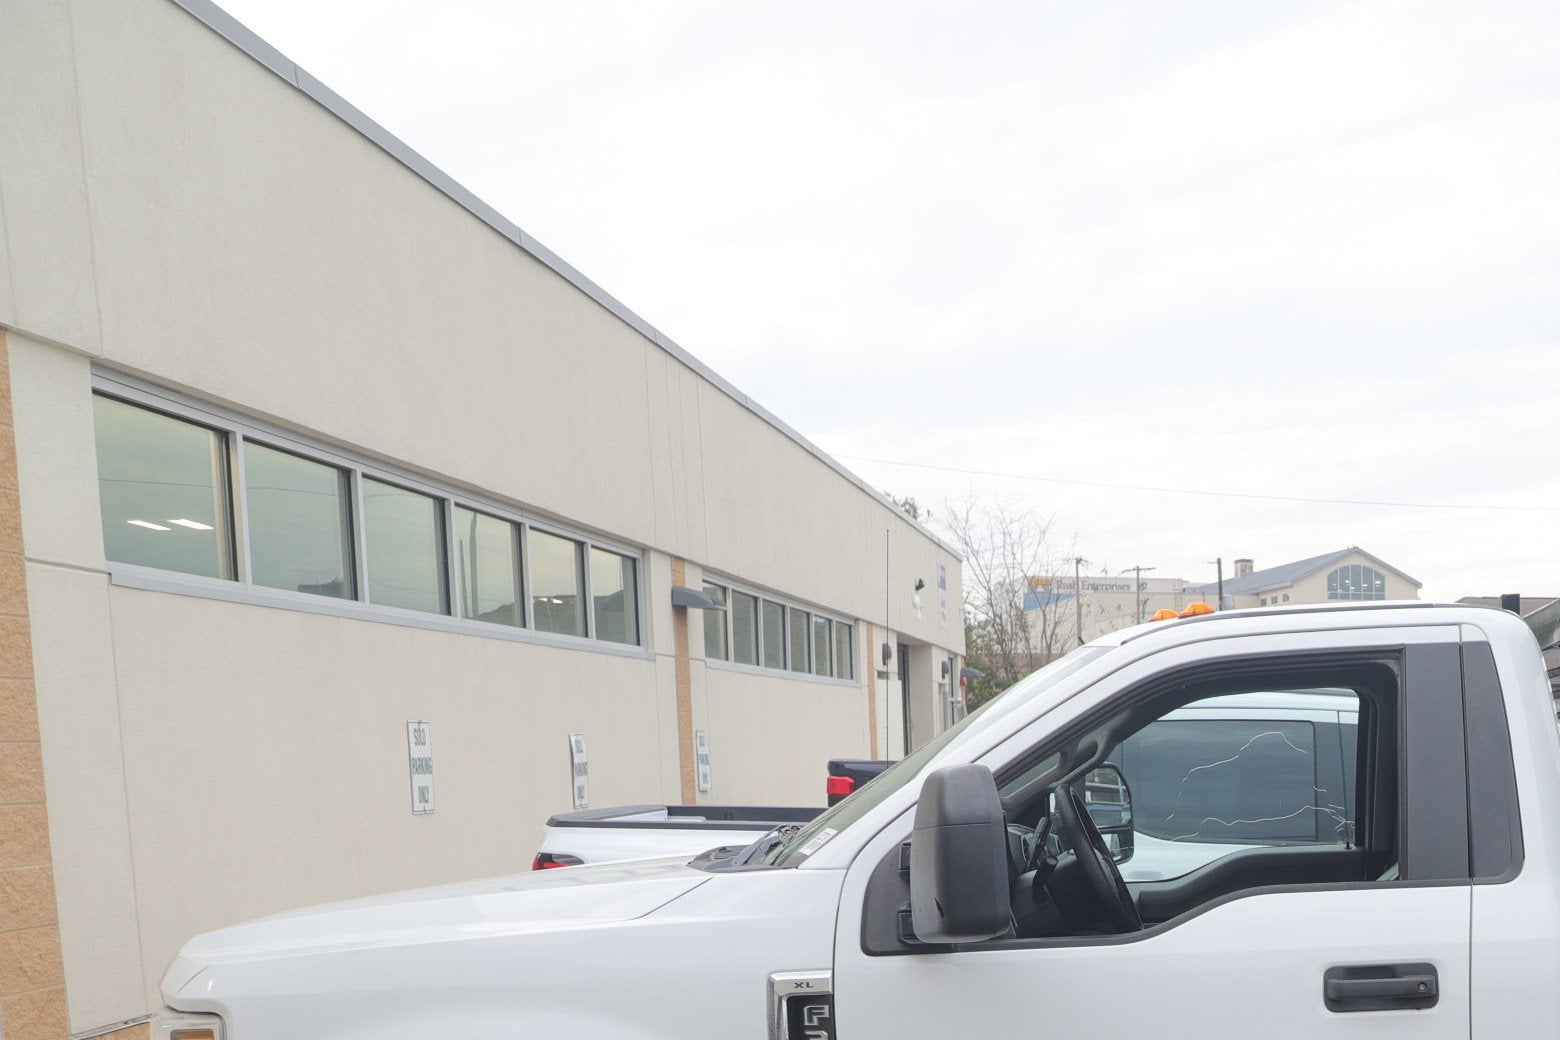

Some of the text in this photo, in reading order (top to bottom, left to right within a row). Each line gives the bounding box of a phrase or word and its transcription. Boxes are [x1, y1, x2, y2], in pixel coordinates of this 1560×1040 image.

[1081, 580, 1131, 592] Enterprises
[413, 728, 426, 746] SOLD
[411, 757, 433, 775] PARKING
[418, 786, 429, 804] ONLY
